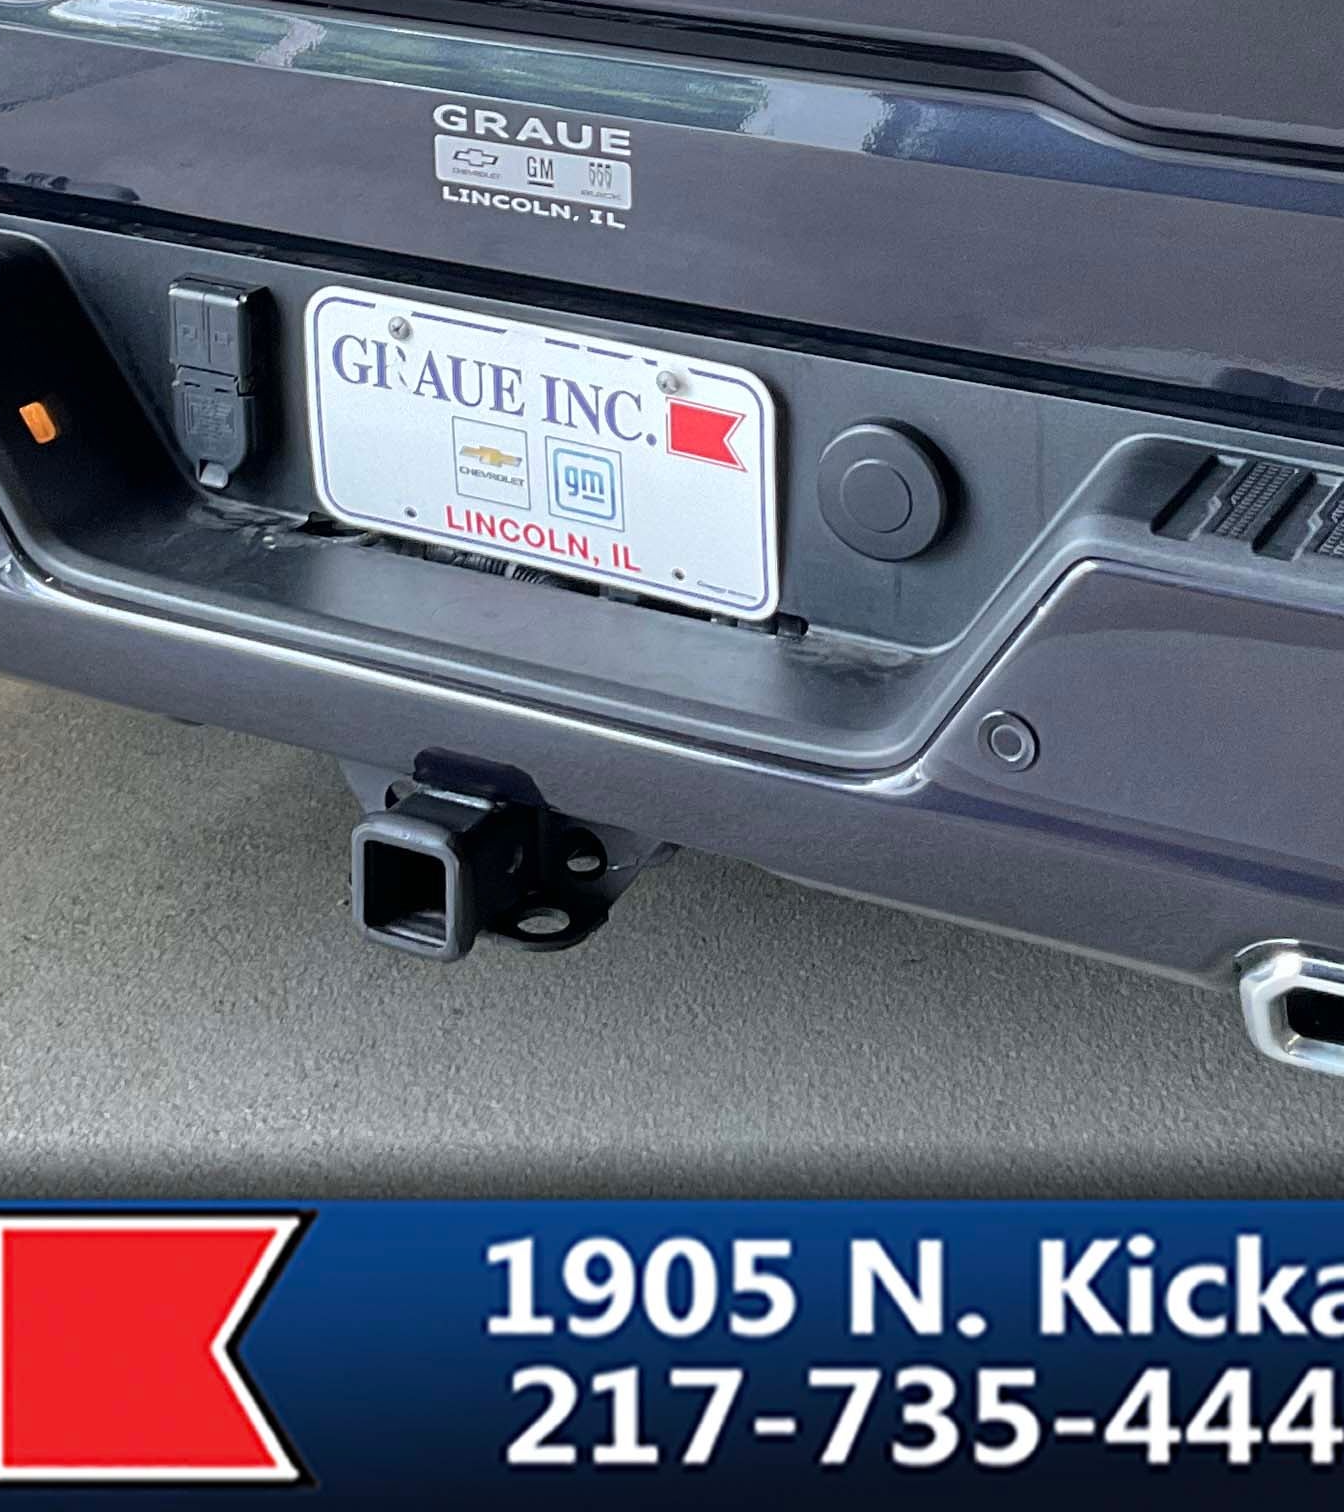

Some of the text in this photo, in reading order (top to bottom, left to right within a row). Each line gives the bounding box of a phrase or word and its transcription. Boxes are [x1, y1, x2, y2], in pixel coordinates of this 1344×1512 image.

[433, 104, 632, 156] GRAUE
[527, 156, 554, 181] GM
[443, 186, 627, 229] LINCOLN, IL
[540, 374, 657, 447] INC.
[459, 465, 525, 488] CHEVROLET
[564, 463, 605, 499] gm
[445, 504, 641, 571] LINCOLN, IL
